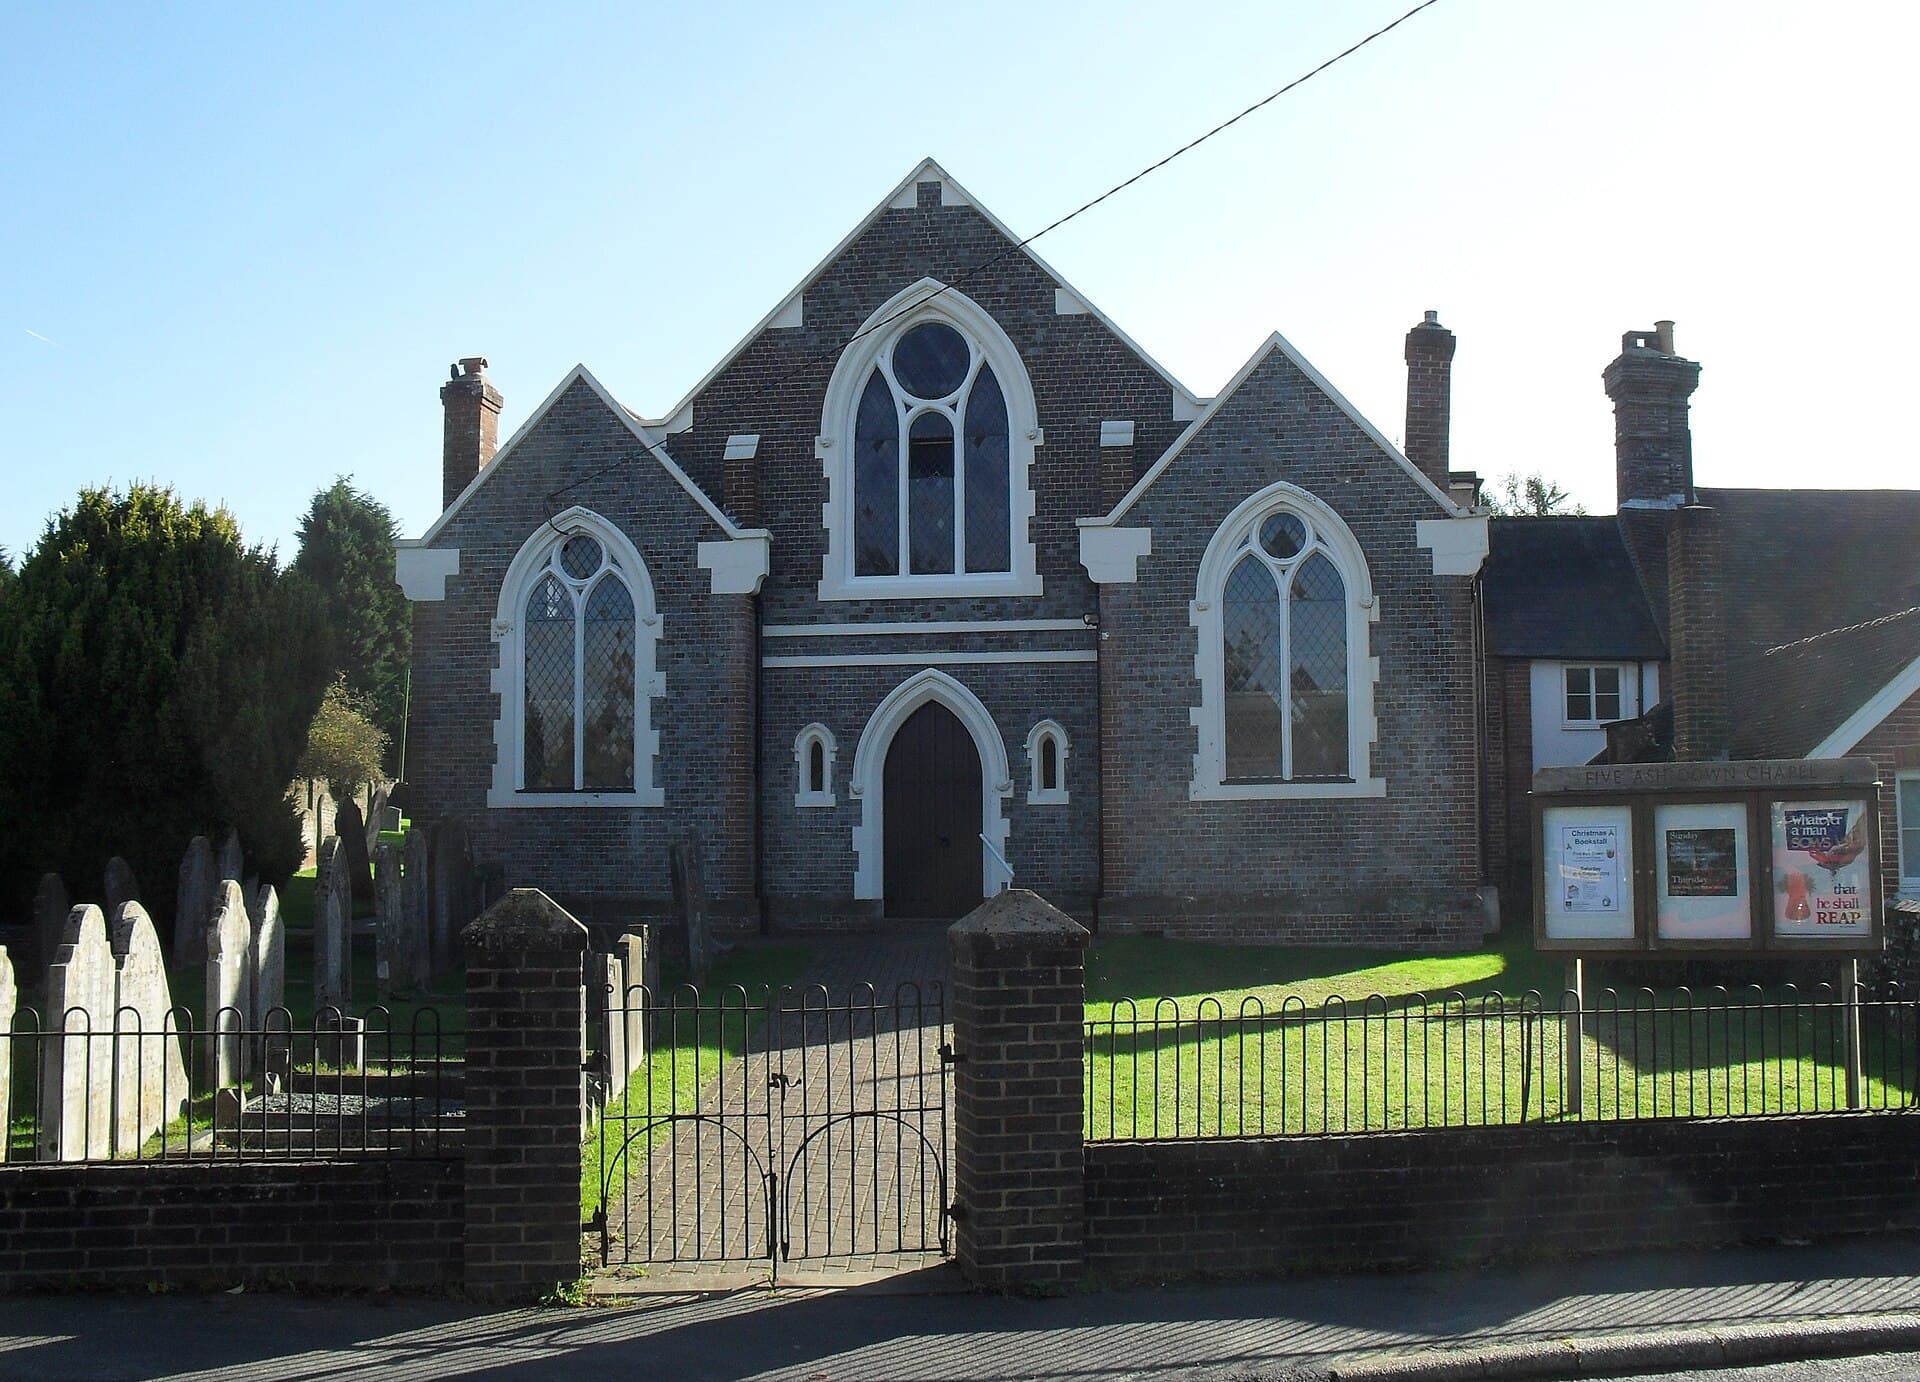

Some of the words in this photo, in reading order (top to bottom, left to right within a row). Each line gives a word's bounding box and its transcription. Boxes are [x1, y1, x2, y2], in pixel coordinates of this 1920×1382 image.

[1586, 769, 1622, 785] FIVE
[1632, 768, 1666, 783] ASH
[1681, 767, 1737, 783] DOWN
[1745, 765, 1818, 781] CHAPEL
[1670, 832, 1698, 840] Sunday
[1791, 828, 1799, 836] a
[1802, 827, 1827, 836] man
[1791, 837, 1831, 848] SOWS
[1672, 876, 1707, 885] Thursday
[1834, 884, 1856, 895] that
[1816, 898, 1830, 909] he
[1832, 898, 1859, 909] shall
[1816, 912, 1861, 924] REAP
